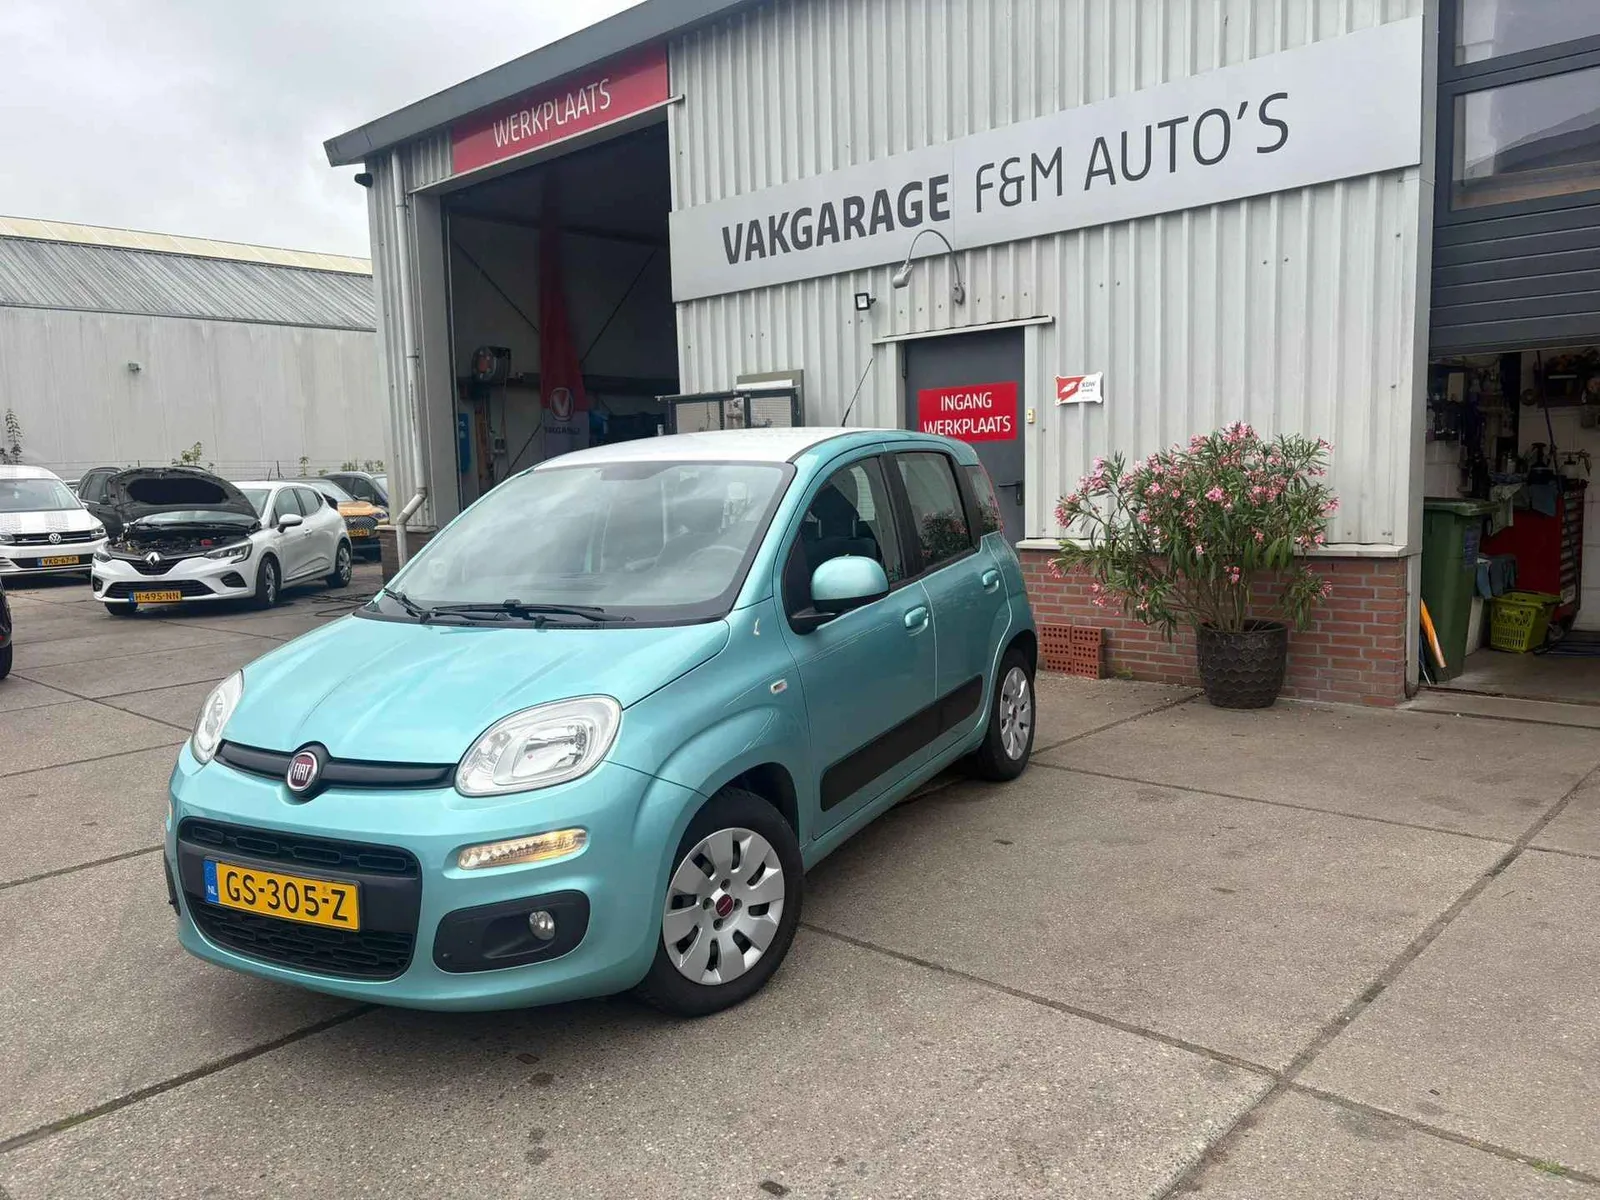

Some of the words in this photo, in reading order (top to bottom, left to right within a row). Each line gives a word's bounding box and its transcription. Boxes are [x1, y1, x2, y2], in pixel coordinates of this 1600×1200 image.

[493, 79, 611, 147] WERKPLAATS
[722, 173, 951, 265] VAKGARAGE
[975, 146, 1063, 213] F&M
[1084, 91, 1289, 191] AUTO'S
[940, 392, 992, 411] INGANG
[923, 415, 1012, 436] WERKPLAATS
[134, 592, 180, 602] H-495-NN
[292, 762, 312, 781] FIAT
[207, 884, 218, 896] NL
[226, 871, 348, 921] GS-305-Z
